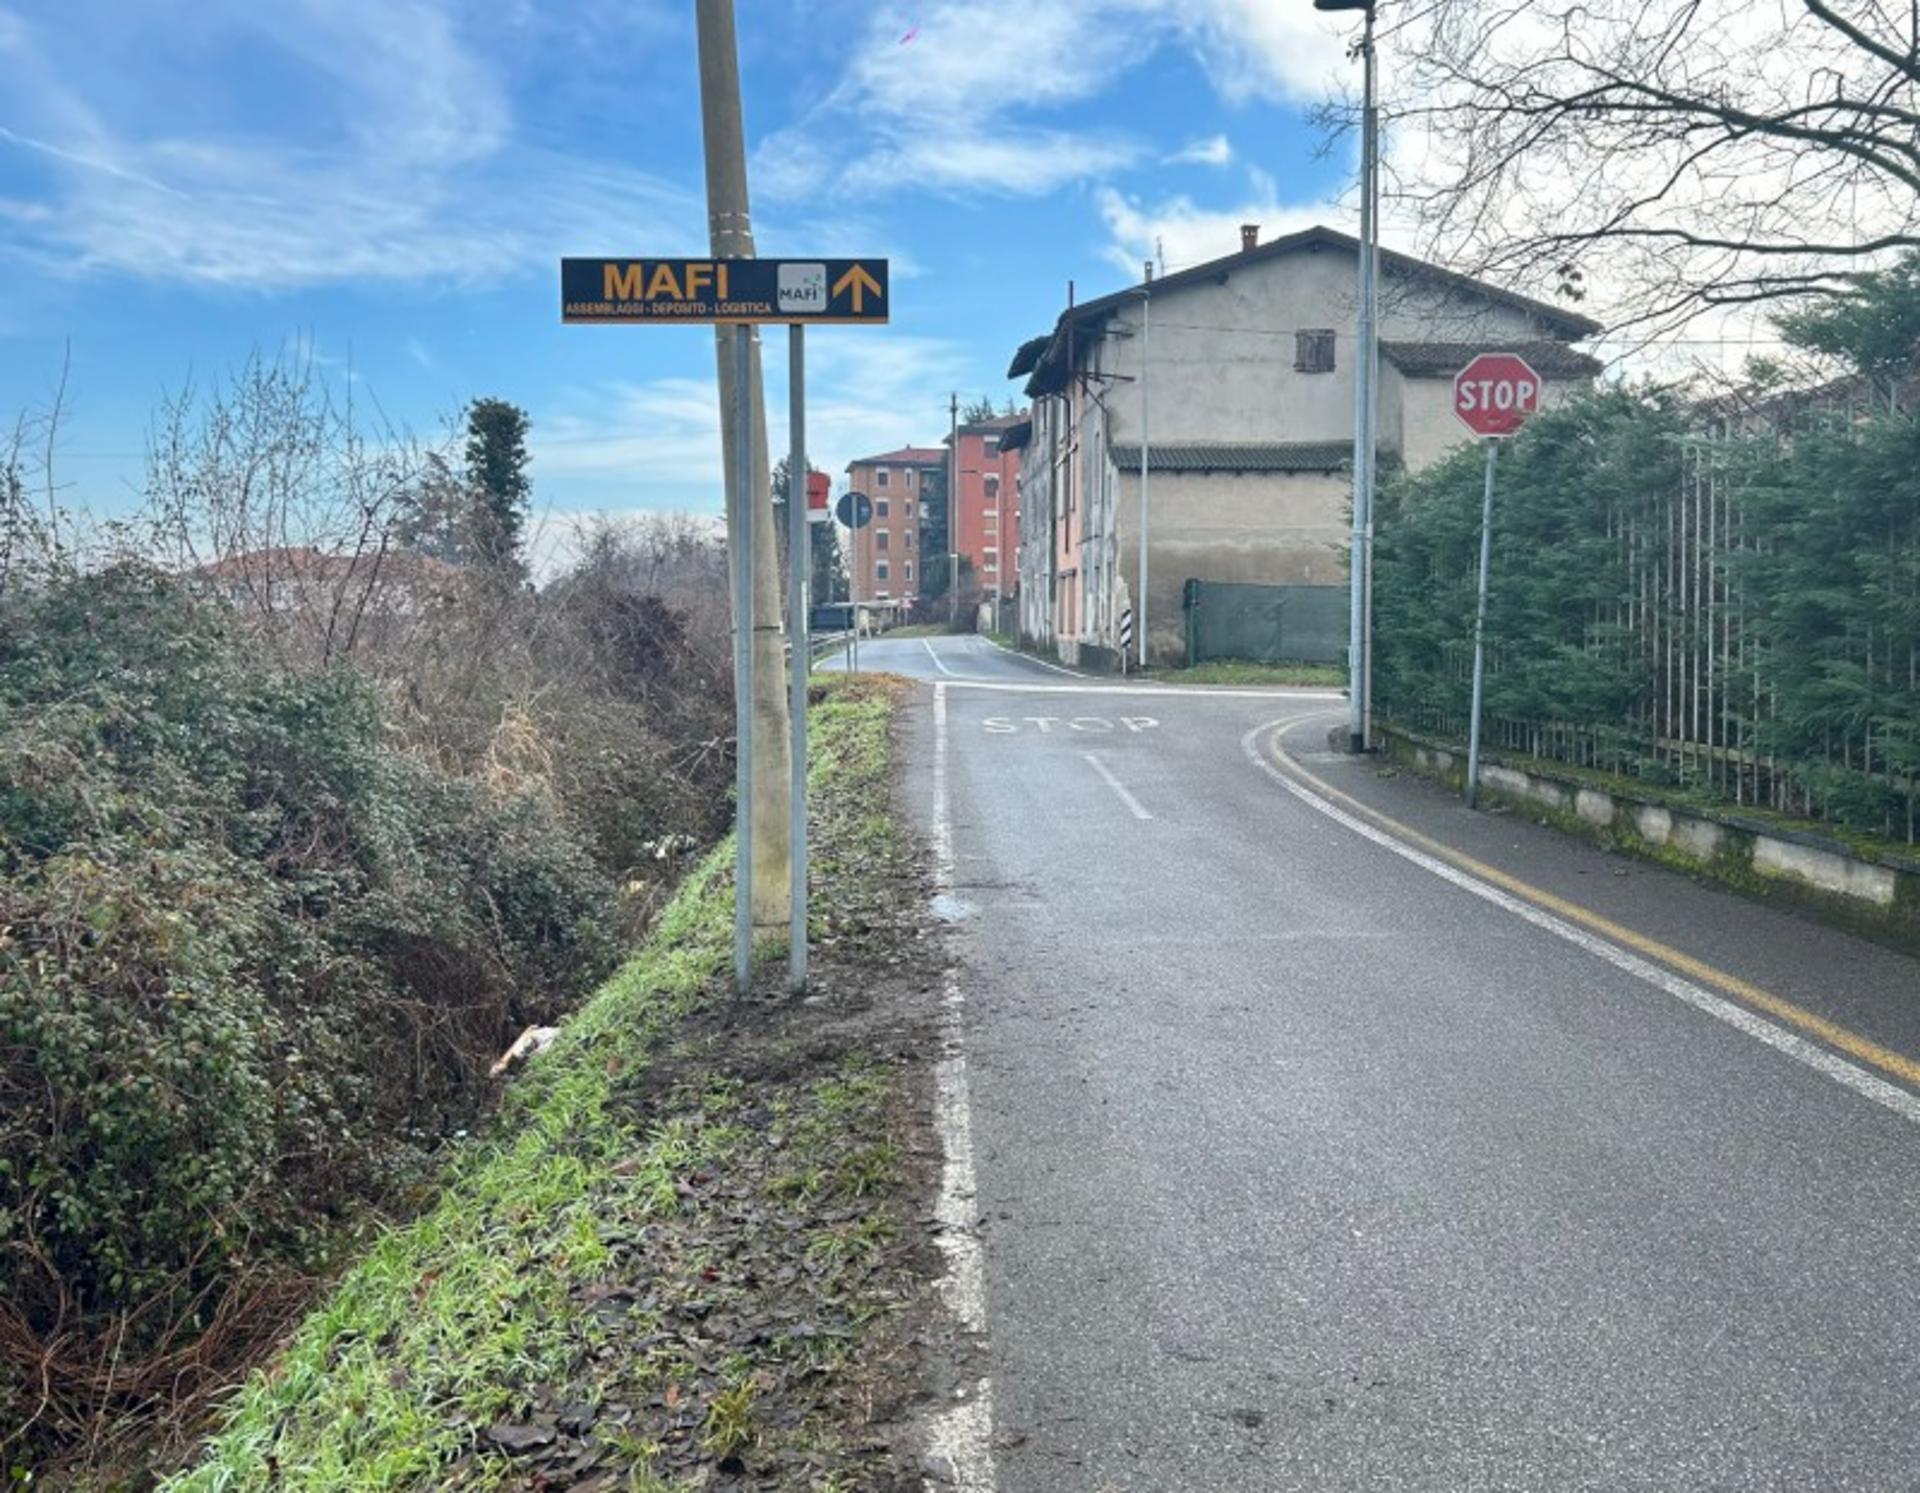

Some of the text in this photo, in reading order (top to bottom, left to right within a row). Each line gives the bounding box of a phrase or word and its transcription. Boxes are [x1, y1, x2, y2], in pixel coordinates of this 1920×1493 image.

[604, 264, 728, 300] MAFI
[779, 284, 817, 300] MAFI
[566, 302, 644, 314] ASSEMBLAGGI
[652, 302, 706, 314] DEPOSITO
[715, 302, 772, 314] LOGISTICA
[1459, 381, 1534, 410] STOP
[983, 716, 1161, 733] STOP
